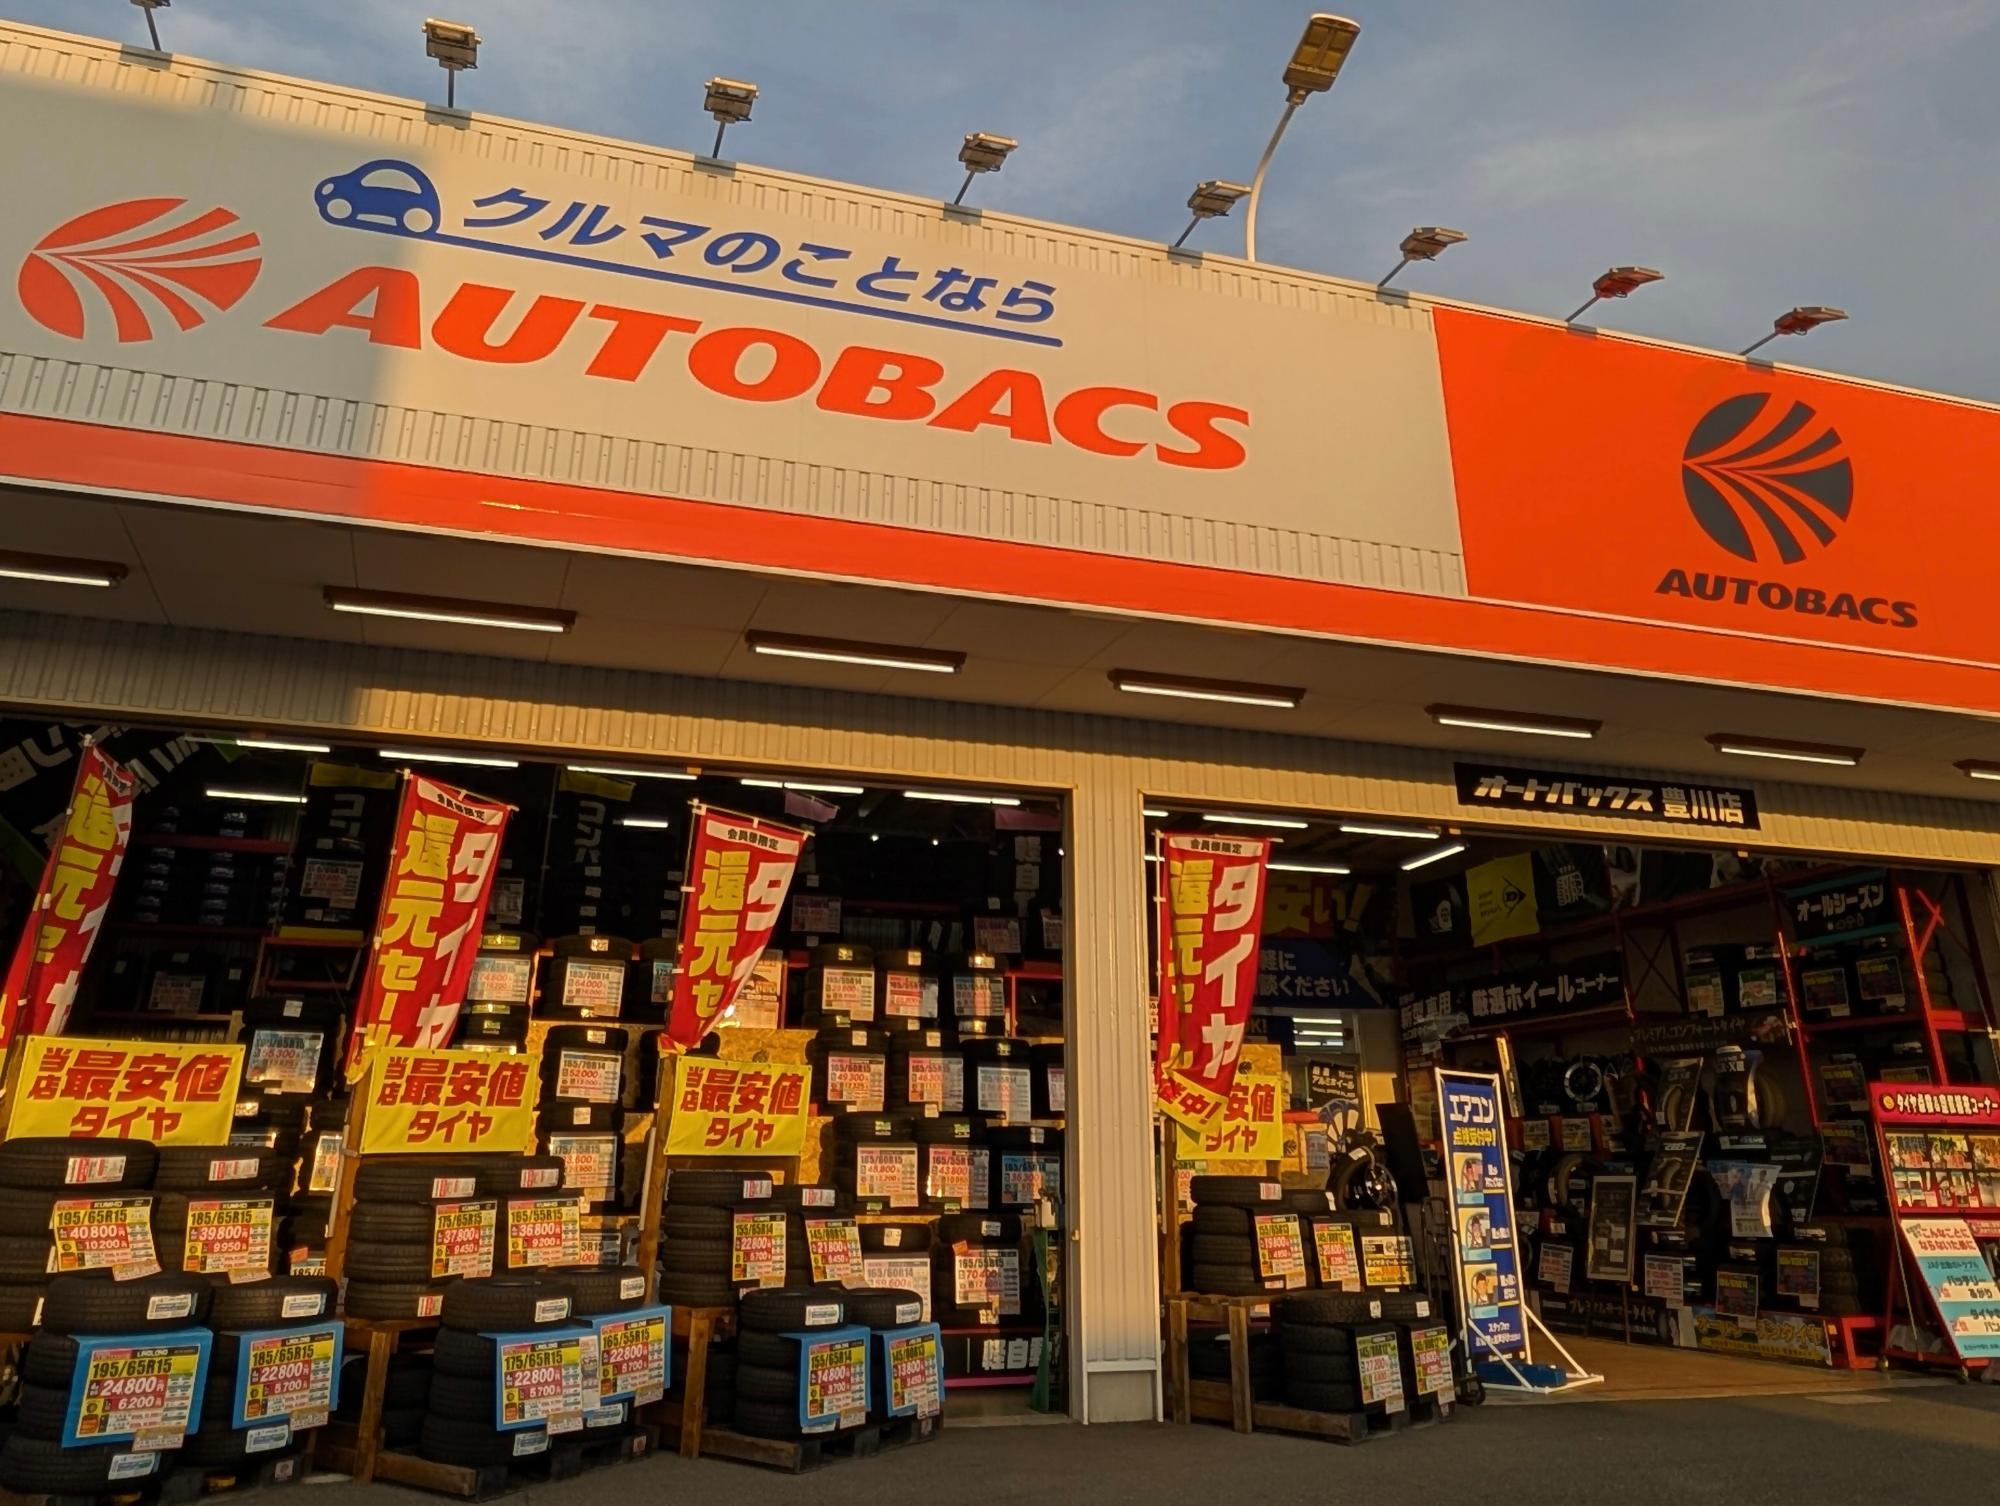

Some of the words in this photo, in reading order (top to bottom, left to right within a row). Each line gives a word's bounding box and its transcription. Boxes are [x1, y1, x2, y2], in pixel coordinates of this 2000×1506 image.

[463, 187, 1056, 323] クルマのことなら
[262, 266, 1250, 469] AUTOBACS
[1654, 568, 1918, 628] AUTOBACS
[413, 832, 498, 1048] タイヤ
[1201, 862, 1260, 1079] タイヤ
[27, 1047, 71, 1100] 当店
[61, 1050, 232, 1102] 最安値
[377, 1057, 409, 1105] 当店
[400, 1058, 529, 1107] 最安値
[680, 1067, 705, 1112] 当店
[700, 1068, 804, 1115] 最安値
[1224, 1082, 1275, 1122] 安値
[69, 1106, 182, 1140] タイヤ
[1449, 1095, 1494, 1123] エアコン
[407, 1111, 493, 1143] タイヤ
[704, 1118, 775, 1148] タイヤ
[57, 1209, 128, 1225] 195/65R15
[191, 1211, 252, 1225] 185/65R15
[438, 1213, 482, 1228] 175/65R15
[510, 1209, 563, 1223] 165/55R15
[603, 1329, 650, 1348] 165/55R15
[93, 1358, 172, 1378] 195/65R15
[253, 1344, 314, 1366] 185/65R15
[505, 1350, 563, 1370] 175/65R15
